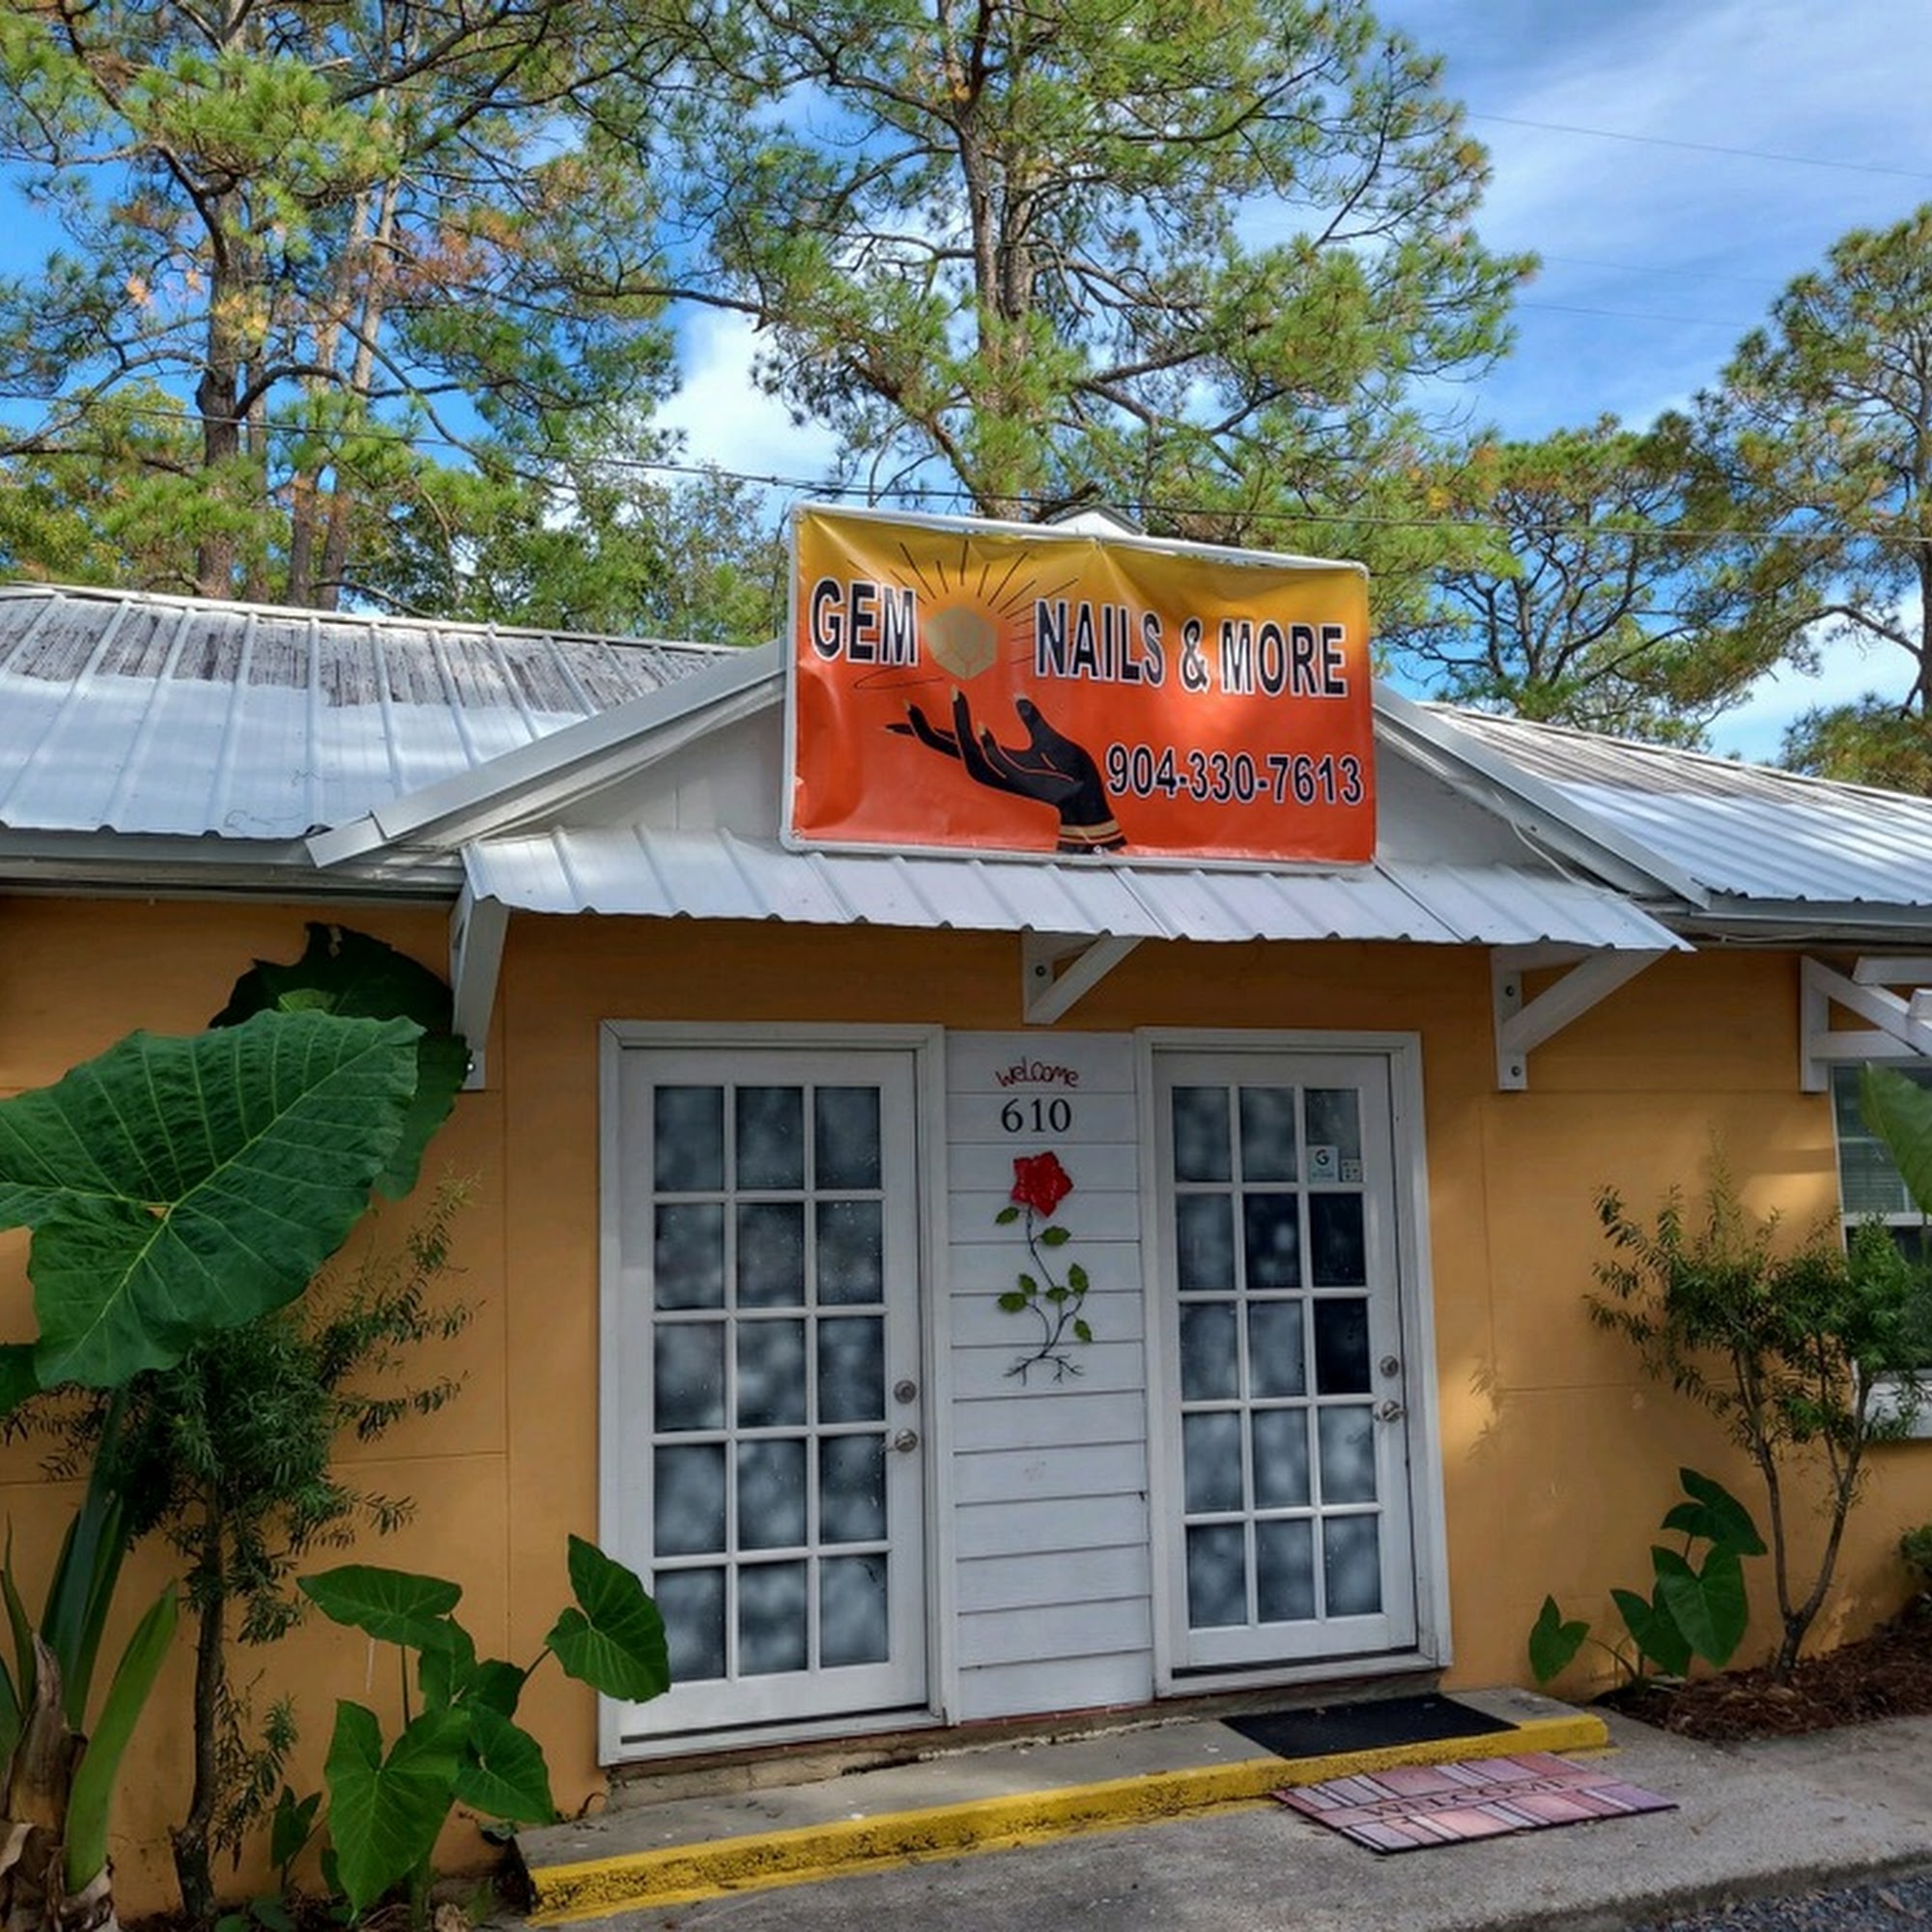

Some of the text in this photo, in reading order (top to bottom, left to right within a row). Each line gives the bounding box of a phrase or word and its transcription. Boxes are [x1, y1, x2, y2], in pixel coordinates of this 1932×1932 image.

[810, 579, 1349, 698] GEM NAILS & MORE
[1105, 743, 1363, 805] 904-330-7613
[995, 1056, 1079, 1088] welcome
[1001, 1097, 1071, 1133] 610
[1316, 1149, 1329, 1166] G
